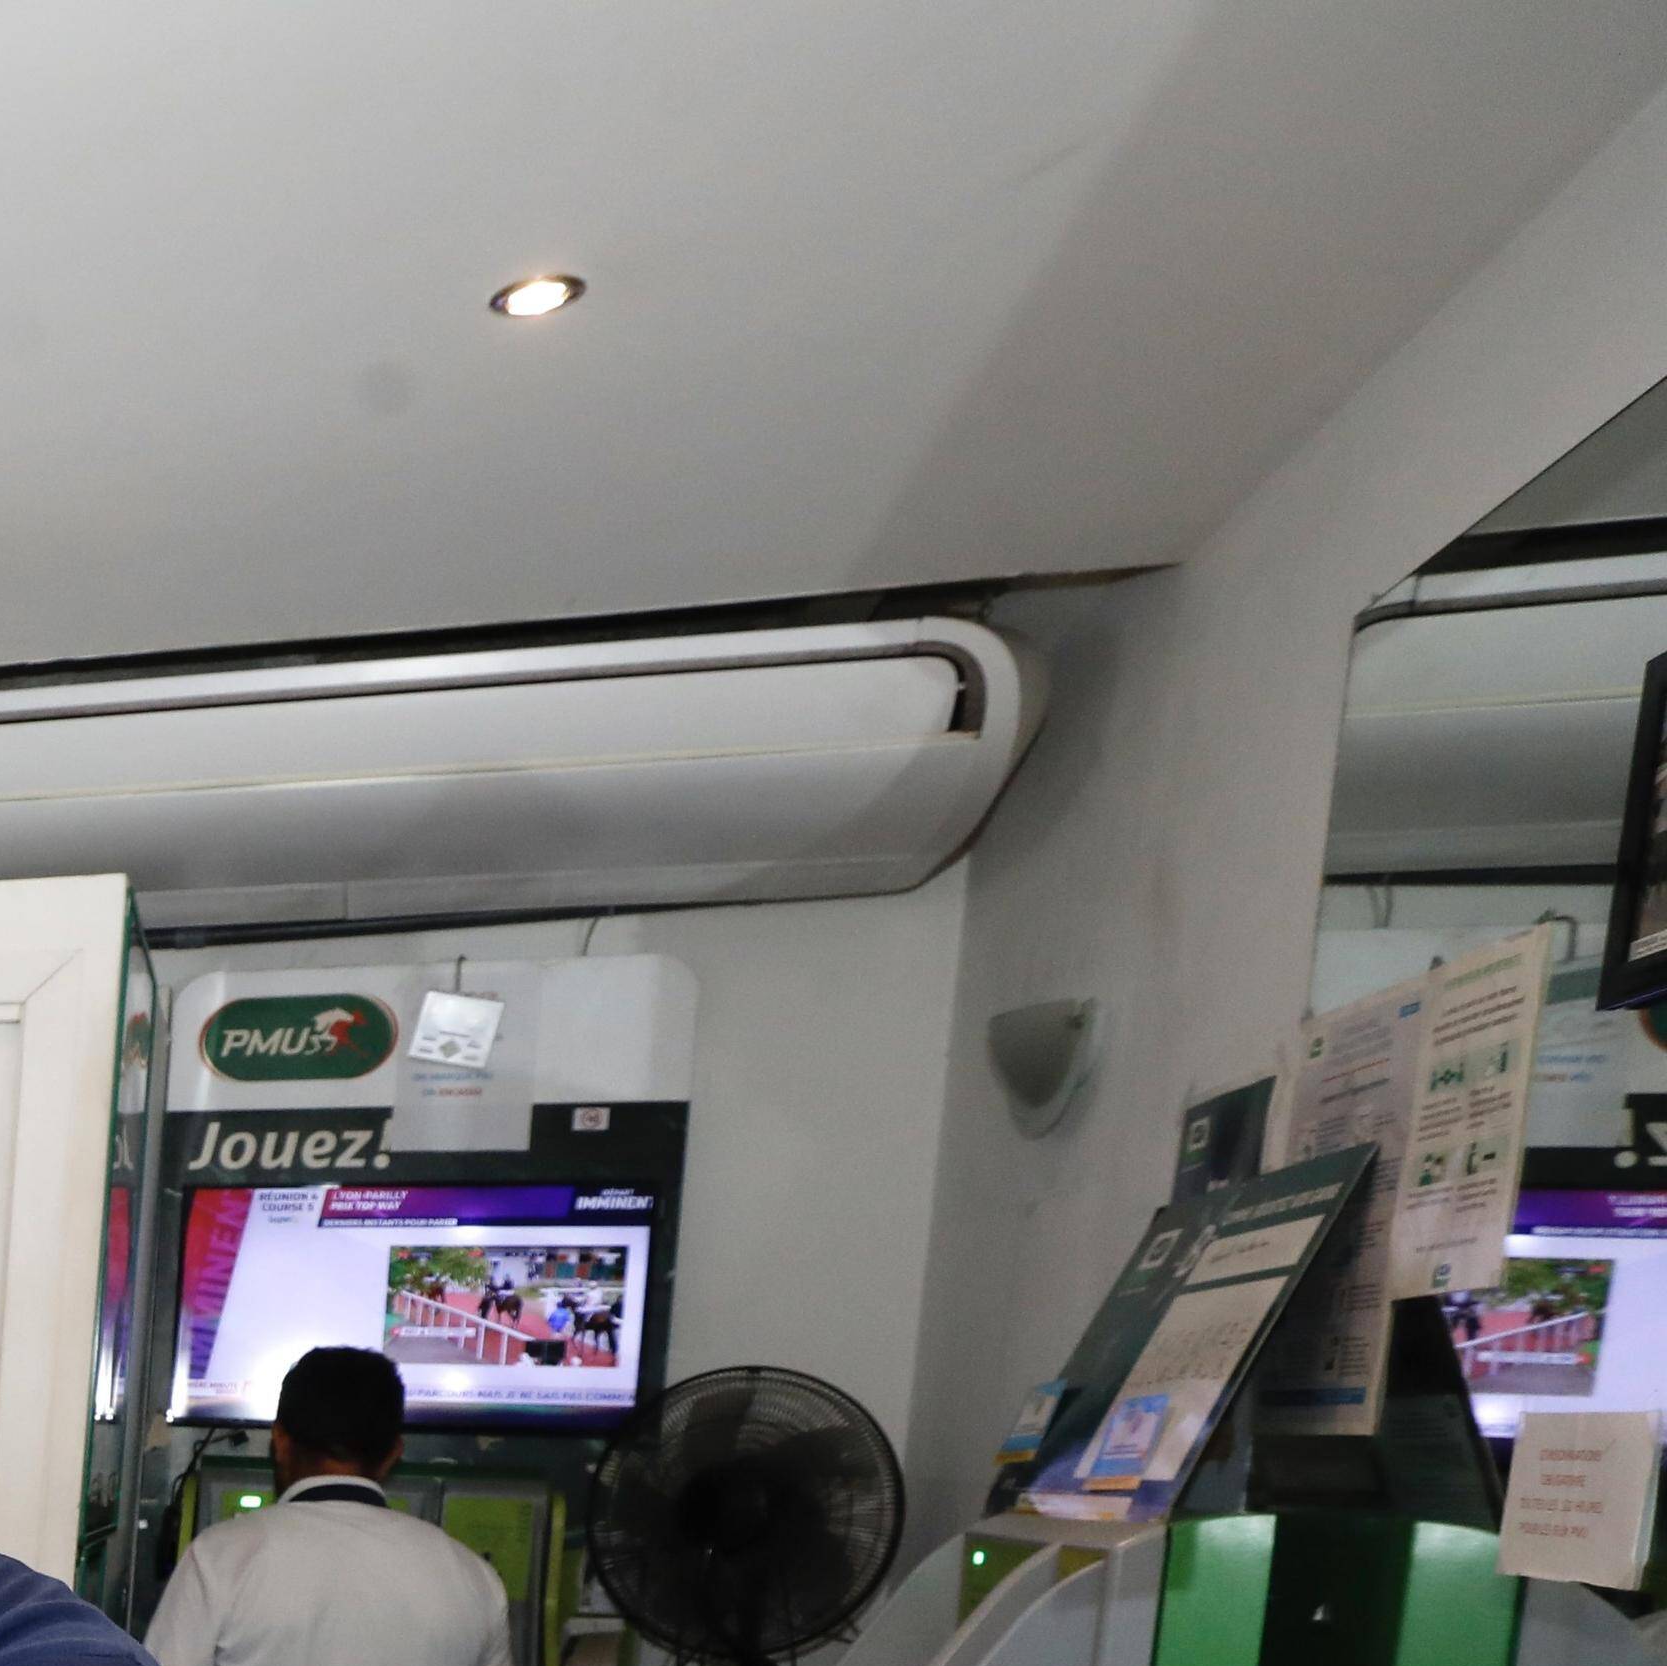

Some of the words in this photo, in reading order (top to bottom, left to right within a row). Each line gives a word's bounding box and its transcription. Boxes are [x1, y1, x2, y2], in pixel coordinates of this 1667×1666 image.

[221, 1027, 309, 1057] PMU
[187, 1118, 393, 1171] Jouez!
[259, 1191, 309, 1201] RÉUNION
[333, 1190, 408, 1201] LYON-PARILLY
[262, 1203, 303, 1212] COURSE
[330, 1202, 358, 1211] PRIX
[359, 1202, 378, 1210] TOP
[378, 1202, 402, 1210] WAY
[478, 1390, 502, 1399] MAIS
